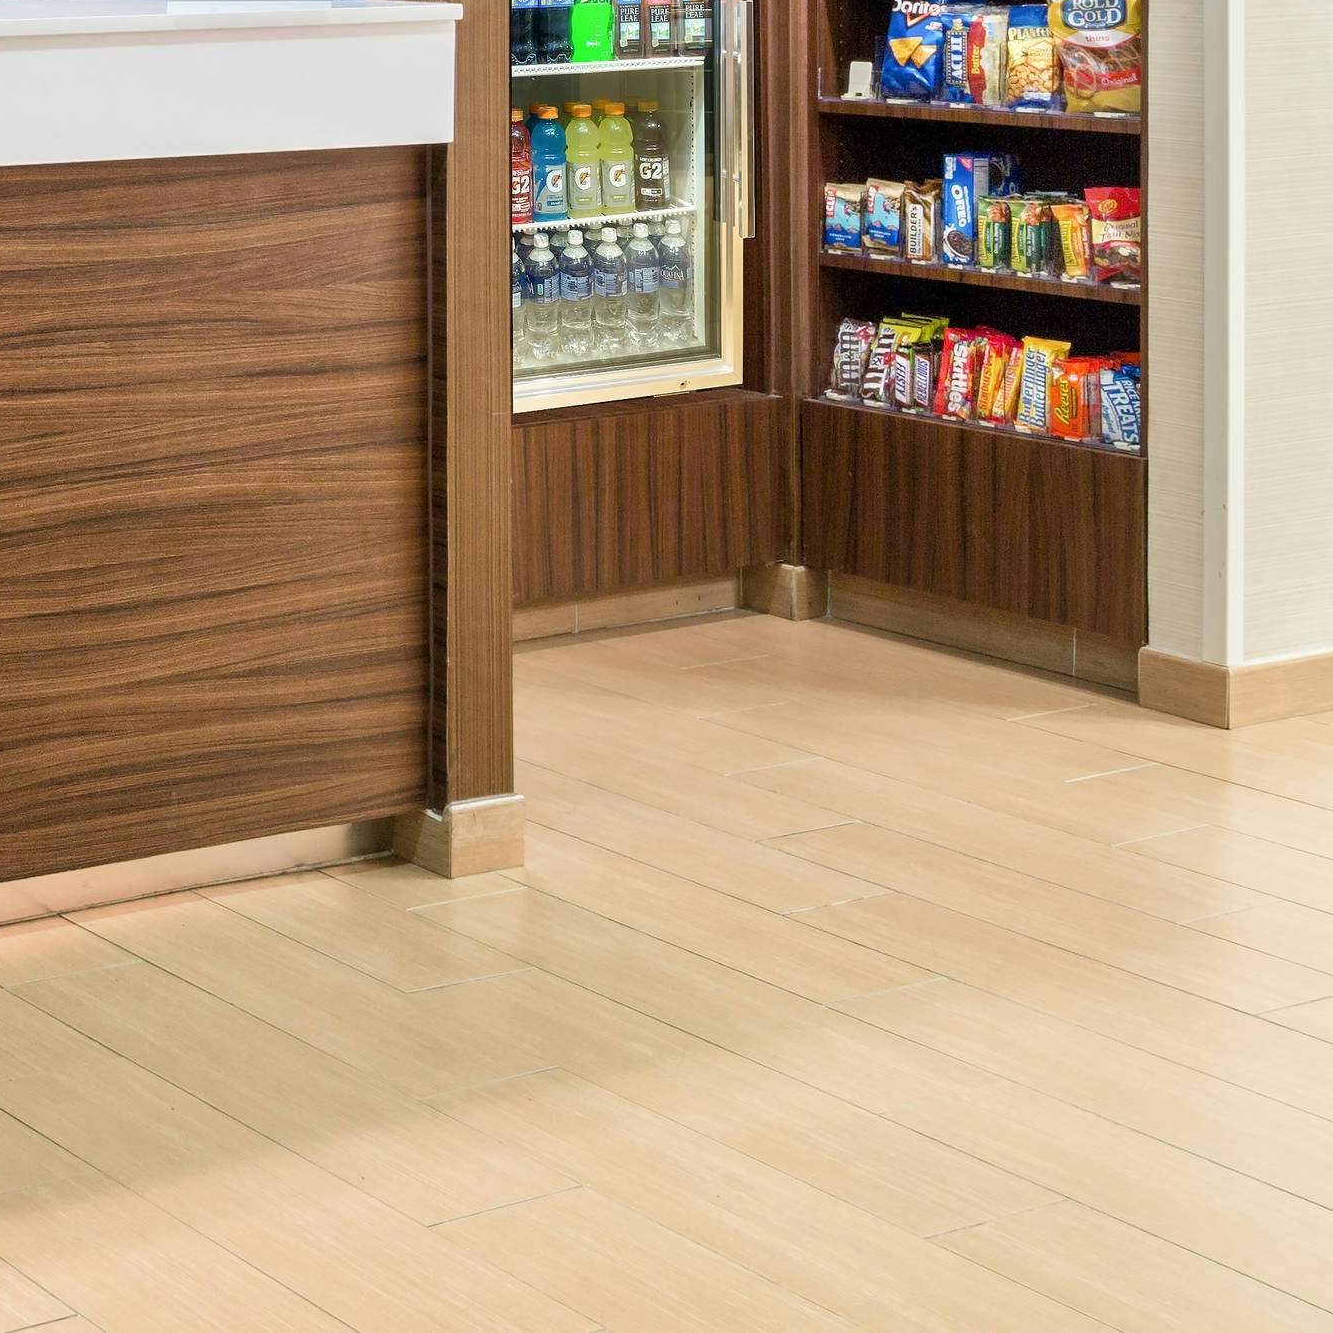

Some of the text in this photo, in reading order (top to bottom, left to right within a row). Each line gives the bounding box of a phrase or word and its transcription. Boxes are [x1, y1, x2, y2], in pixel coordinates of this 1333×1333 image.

[620, 7, 640, 15] PURE
[650, 7, 670, 15] PURE
[685, 3, 705, 12] PURE
[1068, 8, 1122, 27] GOLD
[1085, 34, 1110, 43] thins
[971, 43, 981, 75] Butter
[546, 169, 563, 193] G
[574, 166, 591, 190] G
[609, 163, 627, 187] G
[639, 162, 662, 180] G2
[951, 184, 967, 228] OREO
[916, 358, 929, 402] REBELLIOUS
[948, 343, 968, 413] Skittles
[1029, 349, 1047, 429] Butterfinger
[1121, 378, 1141, 401] RICE
[1101, 379, 1140, 443] TREATS
